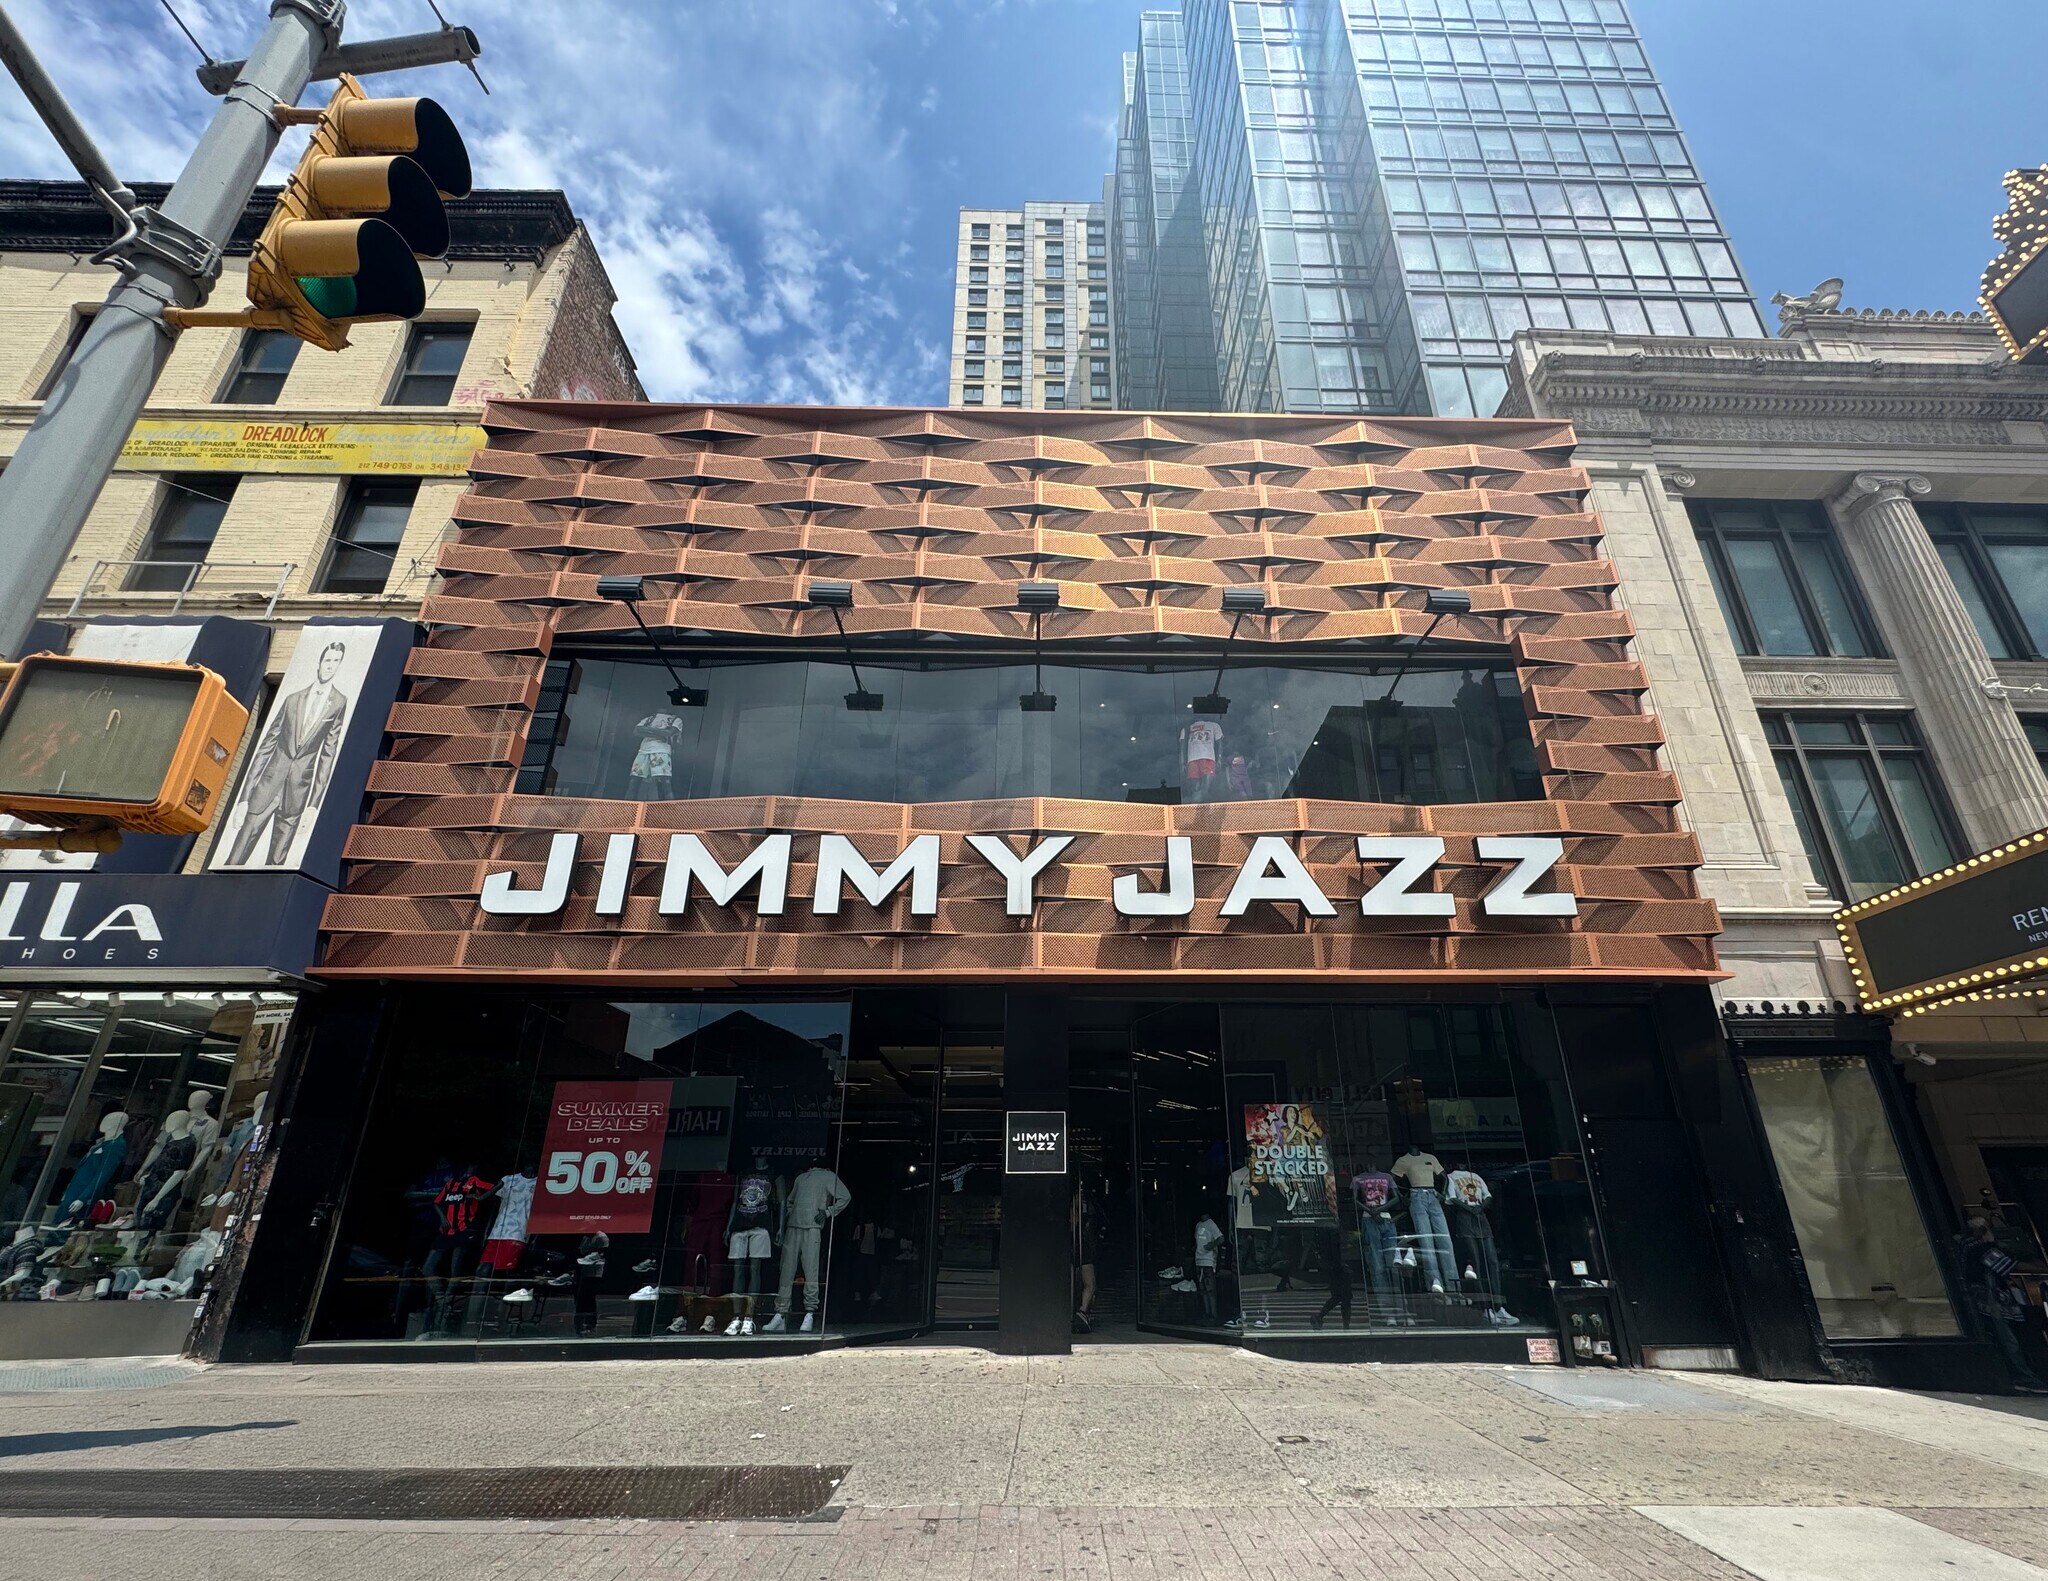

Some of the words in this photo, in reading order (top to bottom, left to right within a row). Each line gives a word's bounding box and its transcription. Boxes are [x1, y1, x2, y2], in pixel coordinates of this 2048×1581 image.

[242, 425, 329, 443] DREADLOCK
[480, 833, 1077, 917] JIMMY
[1113, 835, 1579, 917] JAZZ
[557, 1101, 664, 1116] SUMMER
[567, 1117, 648, 1131] DEALS
[1012, 1132, 1060, 1141] JIMMY
[1017, 1142, 1055, 1151] JAZZ
[1256, 1145, 1324, 1159] DOUBLE
[1254, 1161, 1329, 1175] STACKED
[615, 1177, 653, 1194] OFF
[445, 1193, 464, 1202] Jeep
